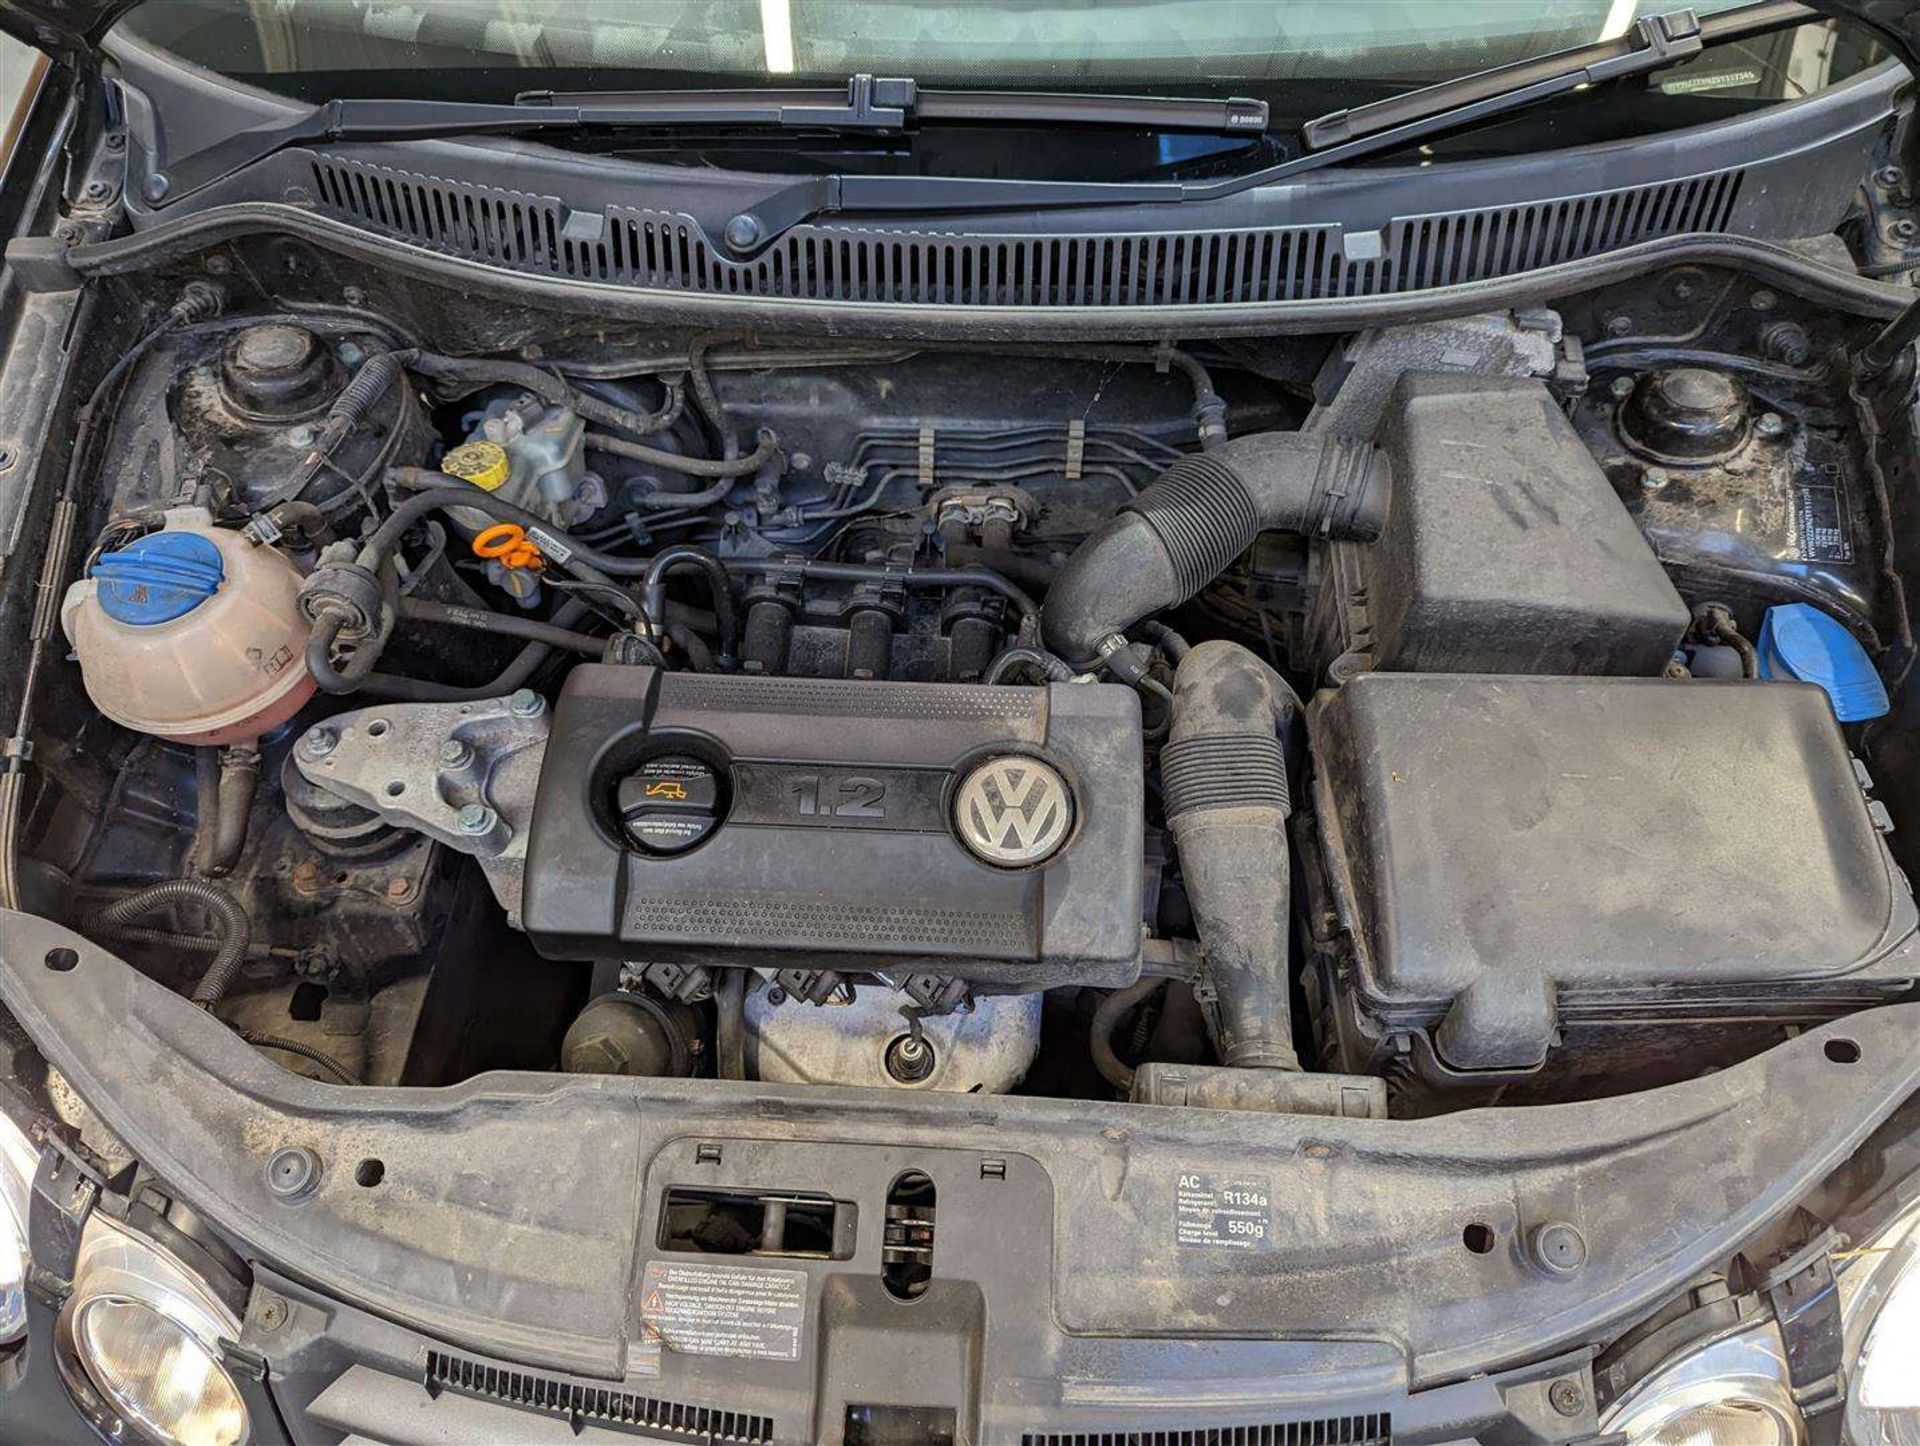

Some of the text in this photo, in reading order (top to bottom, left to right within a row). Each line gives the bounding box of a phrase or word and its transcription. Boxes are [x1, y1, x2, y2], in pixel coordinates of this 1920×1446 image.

[793, 776, 885, 818] 1.2
[956, 756, 1067, 861] VW
[1179, 1175, 1200, 1189] AC
[1223, 1190, 1268, 1206] R134a
[1228, 1220, 1264, 1238] 550g
